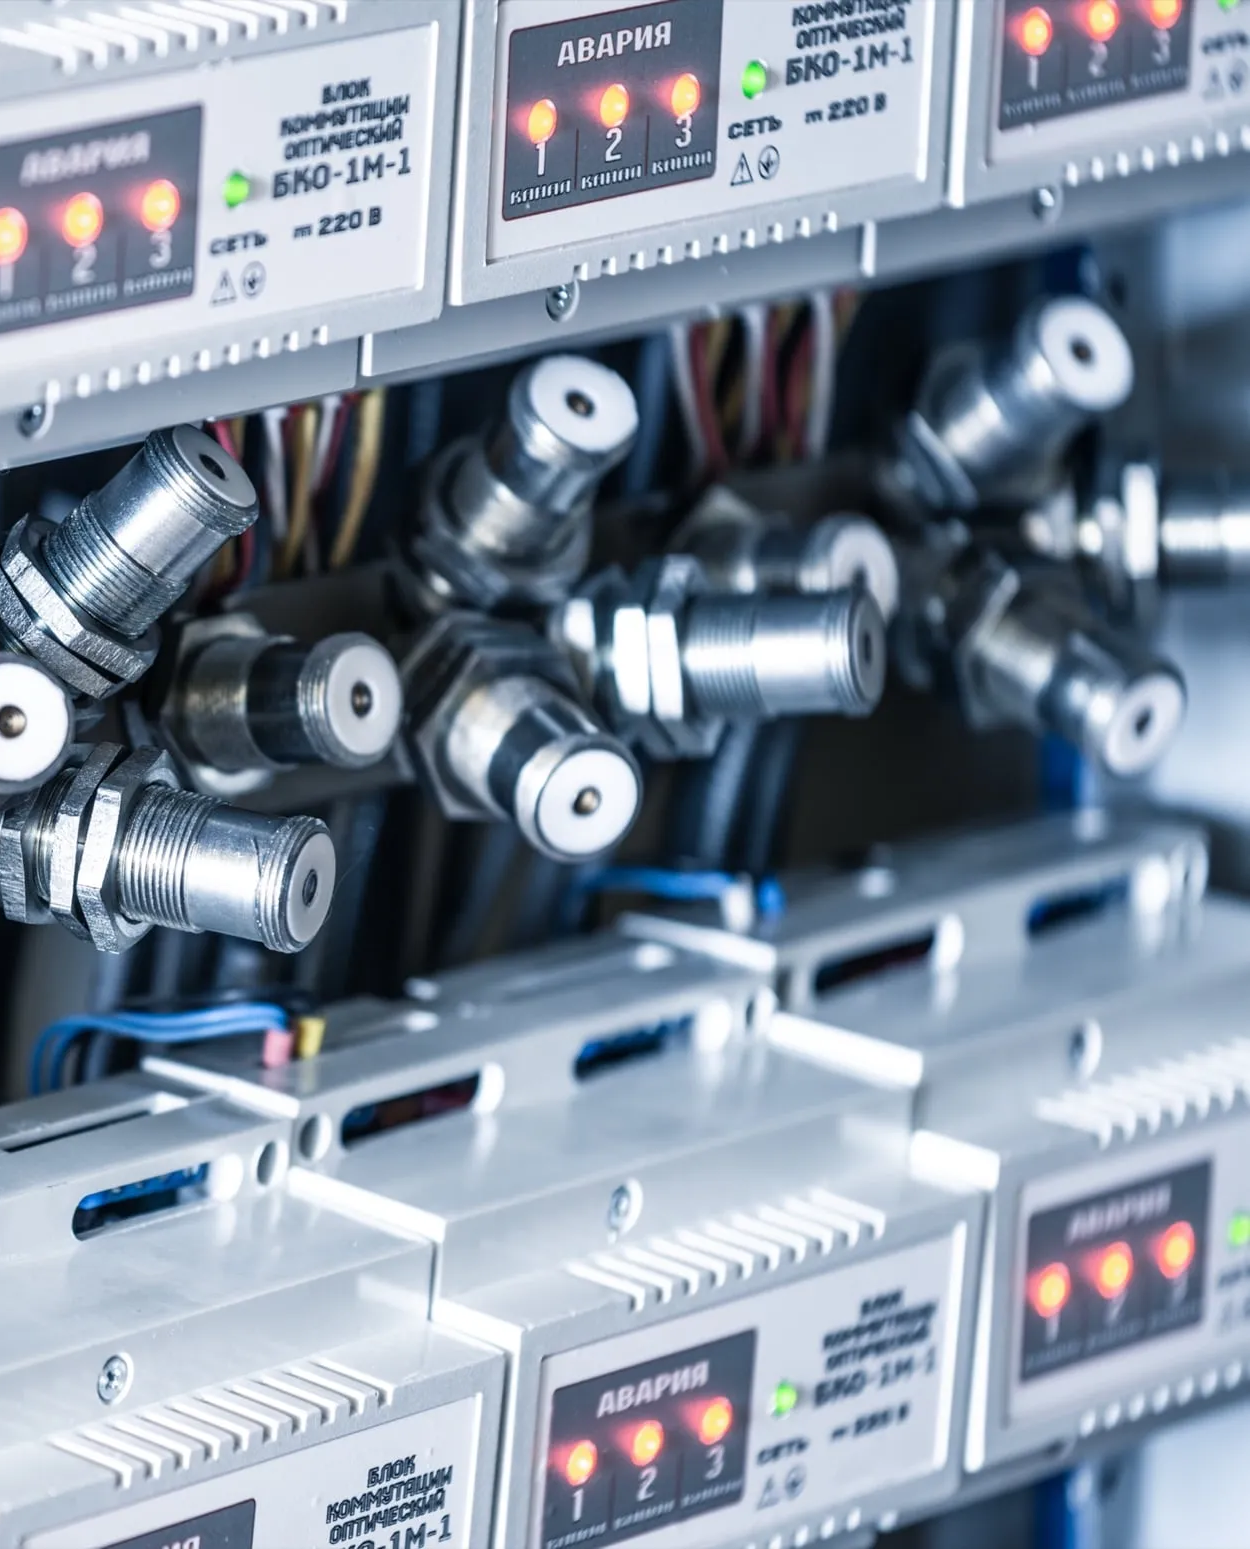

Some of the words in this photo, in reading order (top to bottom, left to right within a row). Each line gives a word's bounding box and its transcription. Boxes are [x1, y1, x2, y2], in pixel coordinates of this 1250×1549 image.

[556, 20, 672, 68] АВАРИЯ
[535, 141, 547, 176] 1
[605, 127, 623, 162] 2
[675, 115, 693, 148] 3
[727, 114, 782, 140] СЕТЬ
[272, 147, 412, 199] БКО-1М-1
[318, 210, 363, 236] 220
[597, 1360, 709, 1419] АВАРИЯ
[326, 1465, 453, 1524] КОММУТАЦИИ
[367, 1454, 416, 1488] БЛОК
[573, 1488, 584, 1522] 1
[636, 1466, 658, 1501] 2
[705, 1445, 725, 1480] 3
[329, 1488, 446, 1544] ОПТИЧЕСКИЙ
